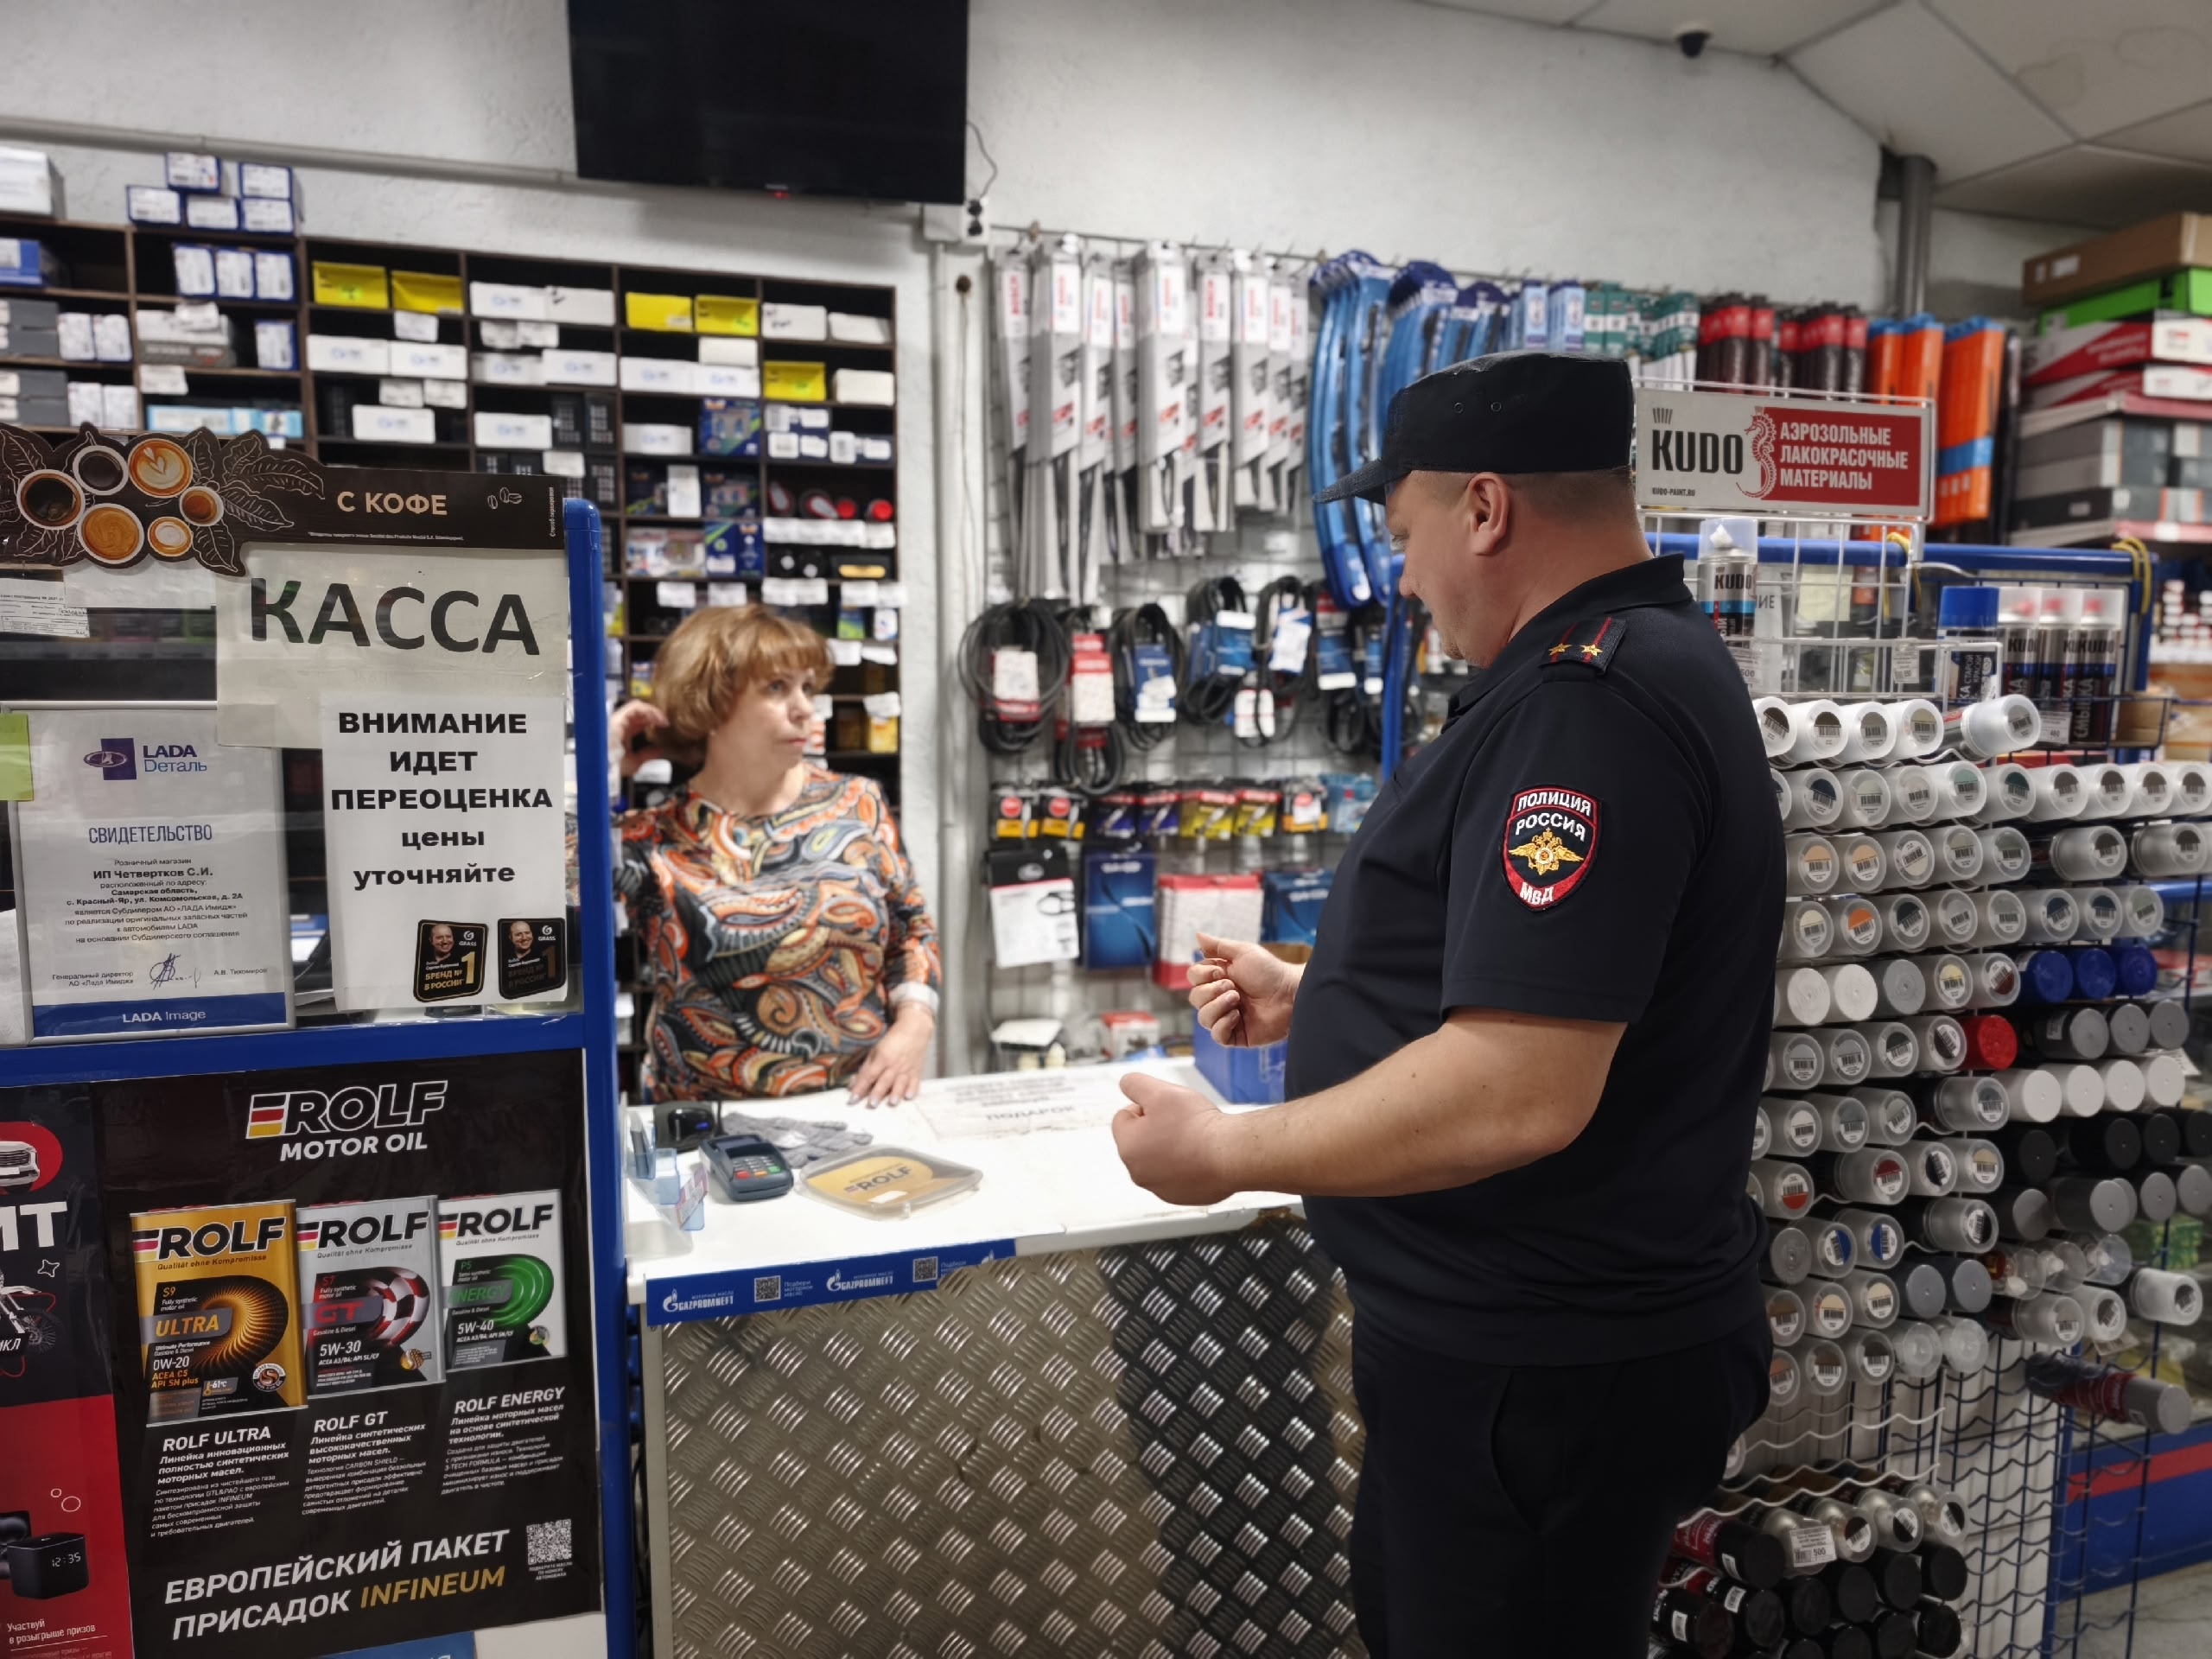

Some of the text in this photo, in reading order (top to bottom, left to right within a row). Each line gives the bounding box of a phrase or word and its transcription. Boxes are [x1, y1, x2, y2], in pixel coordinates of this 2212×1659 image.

[1780, 422, 1891, 446] АЭРОЗОЛЬНЫЕ
[1652, 429, 1744, 474] KUDO
[1780, 445, 1909, 469] ЛАКОКРАСОЧНЫЕ
[1780, 468, 1872, 490] МАТЕРИАЛЫ
[337, 491, 448, 515] С КОФЕ
[1652, 487, 1695, 497] KUDO-PAINT.RU
[1714, 574, 1752, 589] KUDO
[250, 576, 541, 656] КАССА
[339, 712, 527, 734] ВНИМАНИЕ
[143, 745, 197, 758] LADA
[390, 752, 478, 776] ИДЕТ
[332, 788, 553, 812] ПЕРЕОЦЕНКА
[1517, 791, 1592, 816] ПОЛИЦИЯ
[88, 824, 213, 845] СВИДЕТЕЛЬСТВО
[1516, 812, 1586, 842] РОССИЯ
[402, 831, 485, 851] цены
[93, 868, 213, 880] ИП Четвертков С.И.
[100, 880, 163, 889] расположенный
[353, 863, 515, 891] уточняйте
[1520, 881, 1555, 906] МВД
[53, 972, 100, 981] Генеральный
[425, 972, 453, 981] БРЕНД
[461, 951, 475, 984] 1
[122, 1011, 207, 1023] LADA Image
[283, 1080, 448, 1135] ROLF
[280, 1132, 428, 1161] MOTOR OIL
[856, 1166, 912, 1190] ROLF
[318, 1211, 429, 1249] ROLF
[457, 1204, 554, 1237] ROLF
[158, 1217, 287, 1260] ROLF
[365, 1244, 412, 1253] Kompromisse
[157, 1262, 188, 1270] Qualität
[212, 1255, 267, 1265] Kompromisse
[162, 1287, 176, 1297] S9
[315, 1301, 363, 1324] GT
[156, 1314, 219, 1337] ULTRA
[458, 1319, 494, 1334] 5W-40
[320, 1340, 361, 1357] 5W-30
[153, 1356, 190, 1371] 0W-20
[151, 1380, 165, 1389] API
[182, 1377, 199, 1387] plus
[454, 1386, 565, 1414] ROLF ENERGY
[314, 1411, 388, 1433] ROLF GT
[451, 1404, 564, 1426] Линейка моторных масел
[463, 1423, 493, 1433] основе
[496, 1413, 560, 1428] синтетической
[162, 1427, 271, 1452] ROLF ULTRA
[309, 1435, 412, 1454] высококачественных
[310, 1424, 427, 1445] Линейка синтетических
[449, 1432, 504, 1445] технологии.
[159, 1442, 287, 1465] Линейка инновационных
[159, 1452, 289, 1475] полностью синтетических
[308, 1448, 391, 1464] моторных масел.
[157, 1468, 245, 1484] моторных масел.
[164, 1529, 511, 1605] ЕВРОПЕЙСКИЙ ПАКЕТ
[173, 1566, 505, 1641] ПРИСАДОК INFINEUM
[7, 1618, 45, 1632] Участвуй
[16, 1629, 65, 1645] розыгрыше
[67, 1624, 96, 1637] призов
